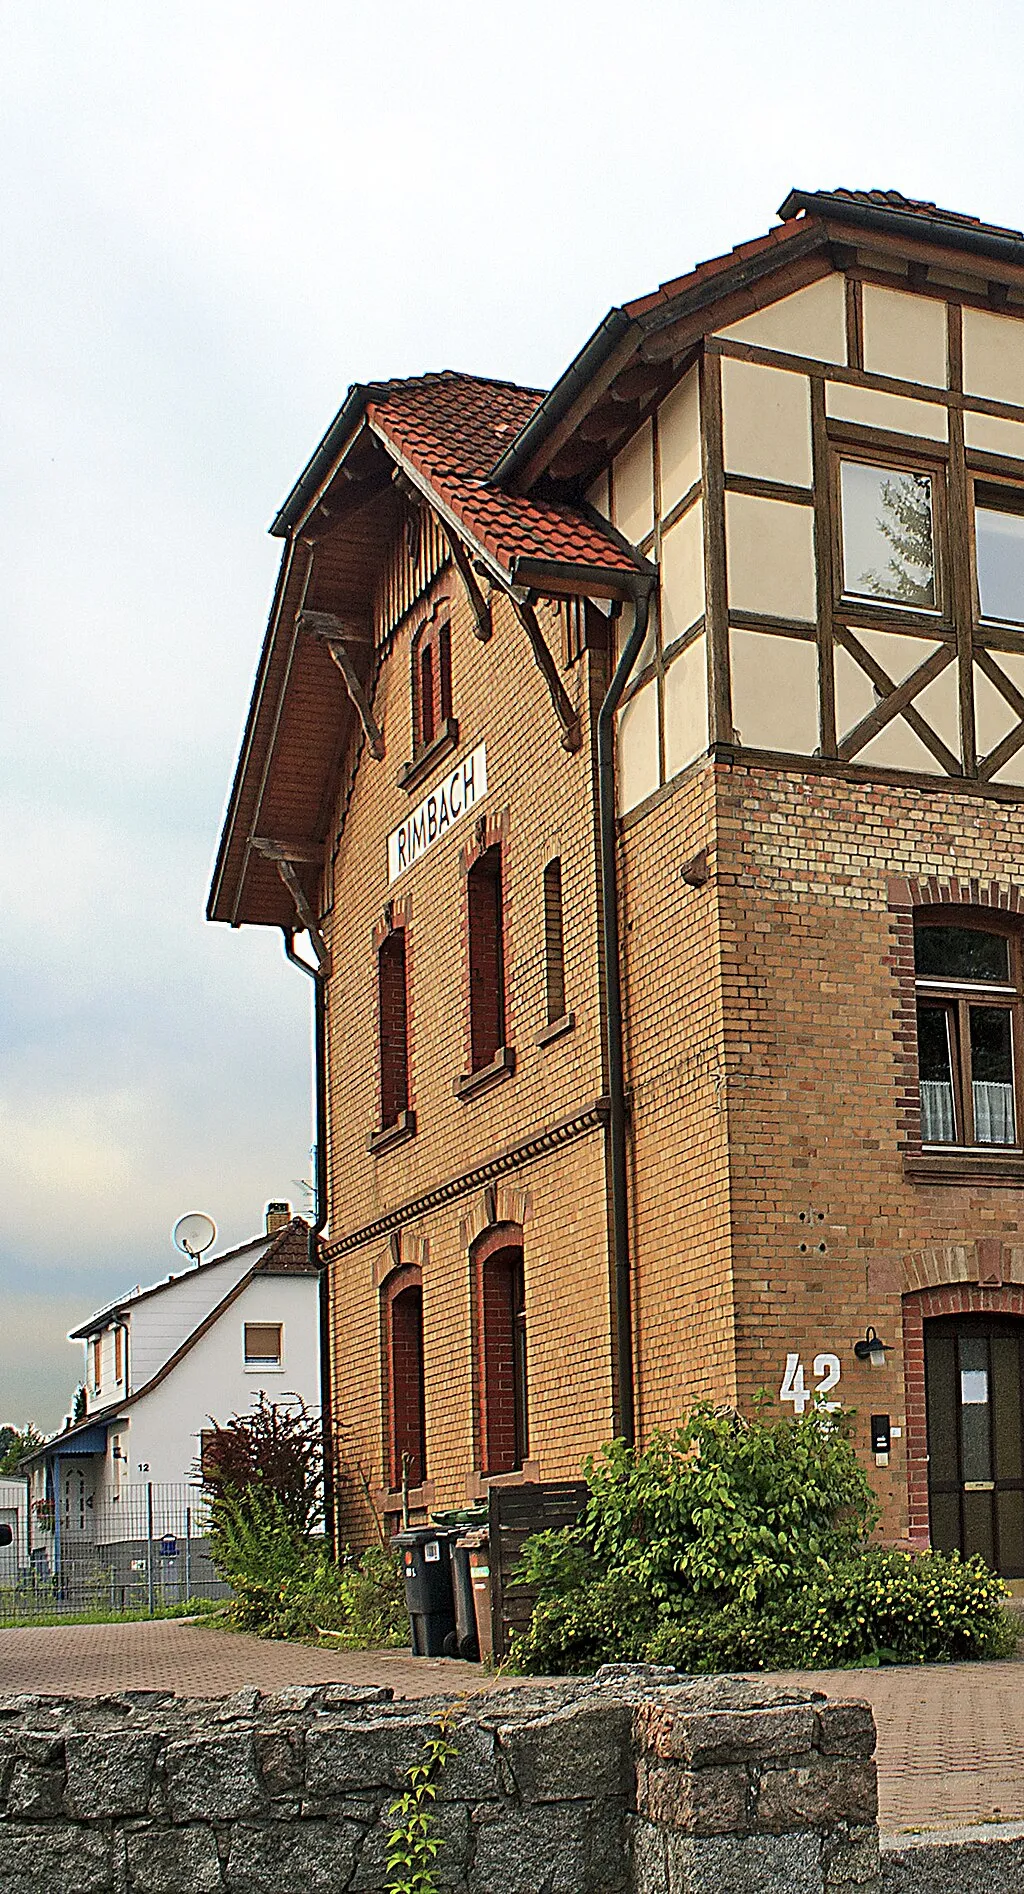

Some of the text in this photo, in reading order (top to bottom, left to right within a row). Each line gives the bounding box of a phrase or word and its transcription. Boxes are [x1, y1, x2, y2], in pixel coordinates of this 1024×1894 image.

[398, 755, 475, 872] RIMBACH
[780, 1353, 842, 1414] 42
[138, 1463, 150, 1472] 12
